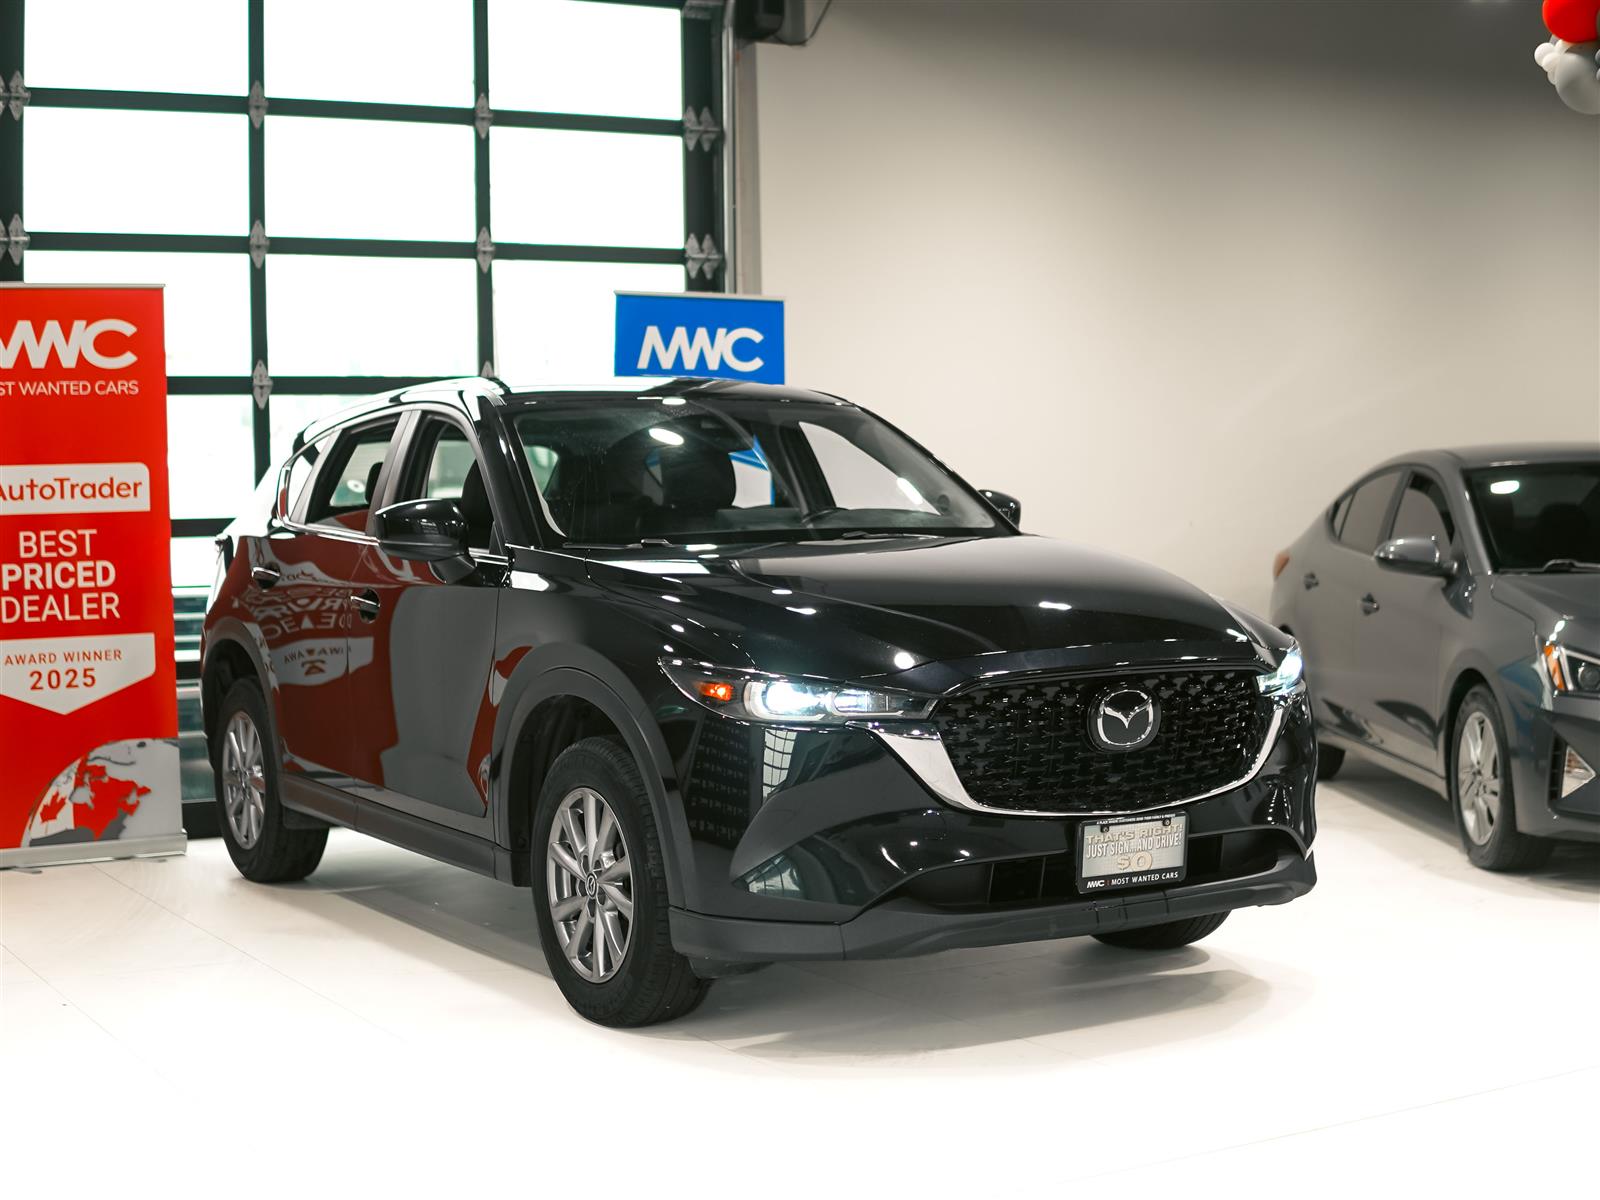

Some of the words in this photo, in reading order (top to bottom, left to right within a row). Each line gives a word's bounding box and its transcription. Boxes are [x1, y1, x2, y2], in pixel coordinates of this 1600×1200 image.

[637, 325, 764, 372] MWC
[19, 380, 91, 396] WANTED
[95, 380, 139, 395] CARS
[19, 529, 97, 558] BEST
[1, 560, 116, 591] PRICED
[0, 592, 121, 624] DEALER
[4, 652, 57, 666] AWARD
[63, 649, 122, 663] WINNER
[29, 667, 96, 691] 2025
[1086, 831, 1135, 844] THAT'S
[1086, 843, 1110, 859] JUST
[1155, 833, 1183, 849] DRIVE!
[1111, 878, 1129, 886] MOST
[1131, 874, 1160, 883] WANTED
[1161, 871, 1179, 880] CARS
